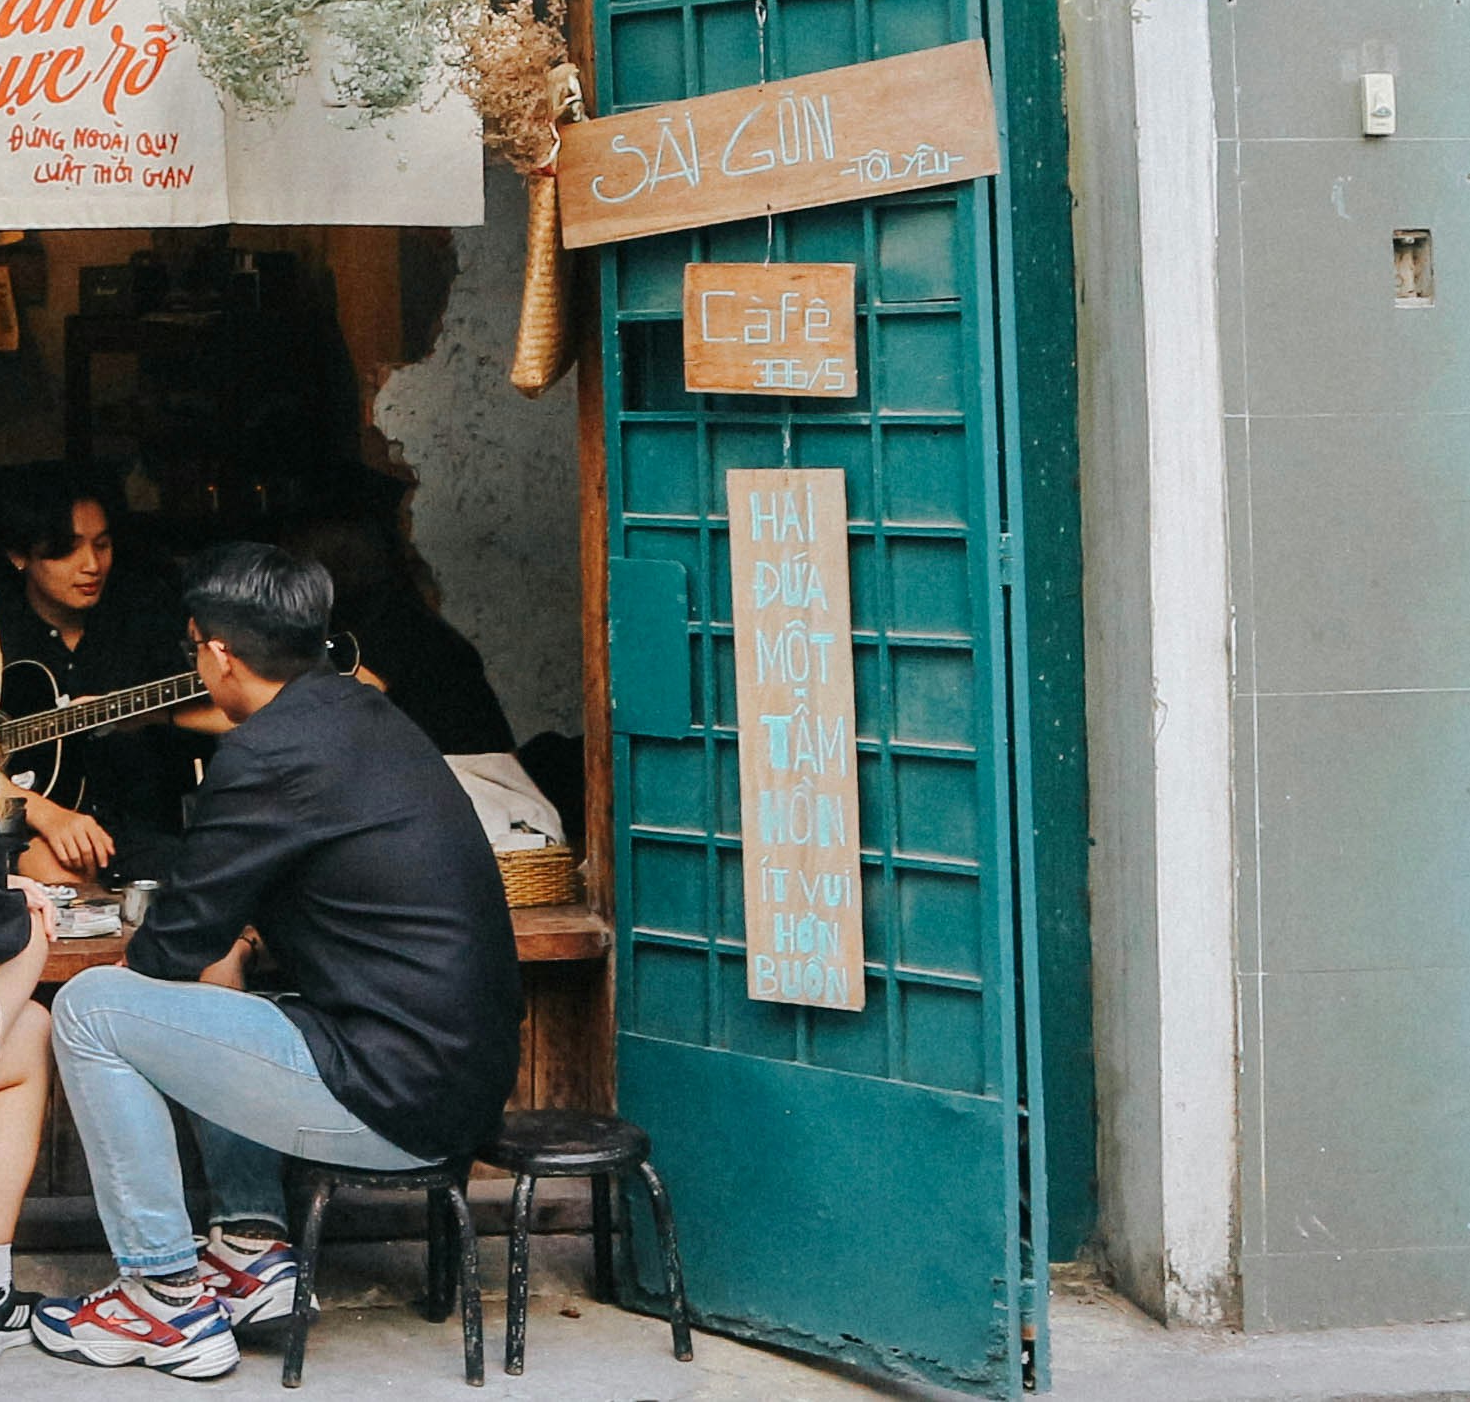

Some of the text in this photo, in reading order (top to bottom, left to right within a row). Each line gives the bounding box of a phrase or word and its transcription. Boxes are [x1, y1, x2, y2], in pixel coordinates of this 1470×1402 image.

[90, 24, 179, 116] rỡ
[6, 111, 180, 158] ĐỨNG NGOÀI QUY
[591, 89, 835, 204] SÀI GÒN
[33, 153, 87, 191] LUẬT
[142, 163, 195, 190] GIAN
[749, 482, 816, 543] HAI
[752, 551, 829, 612] ĐỨA
[755, 619, 835, 697] MỘT
[759, 703, 848, 777] TÂM
[760, 855, 790, 903] ÍT
[773, 911, 839, 958] HƠN
